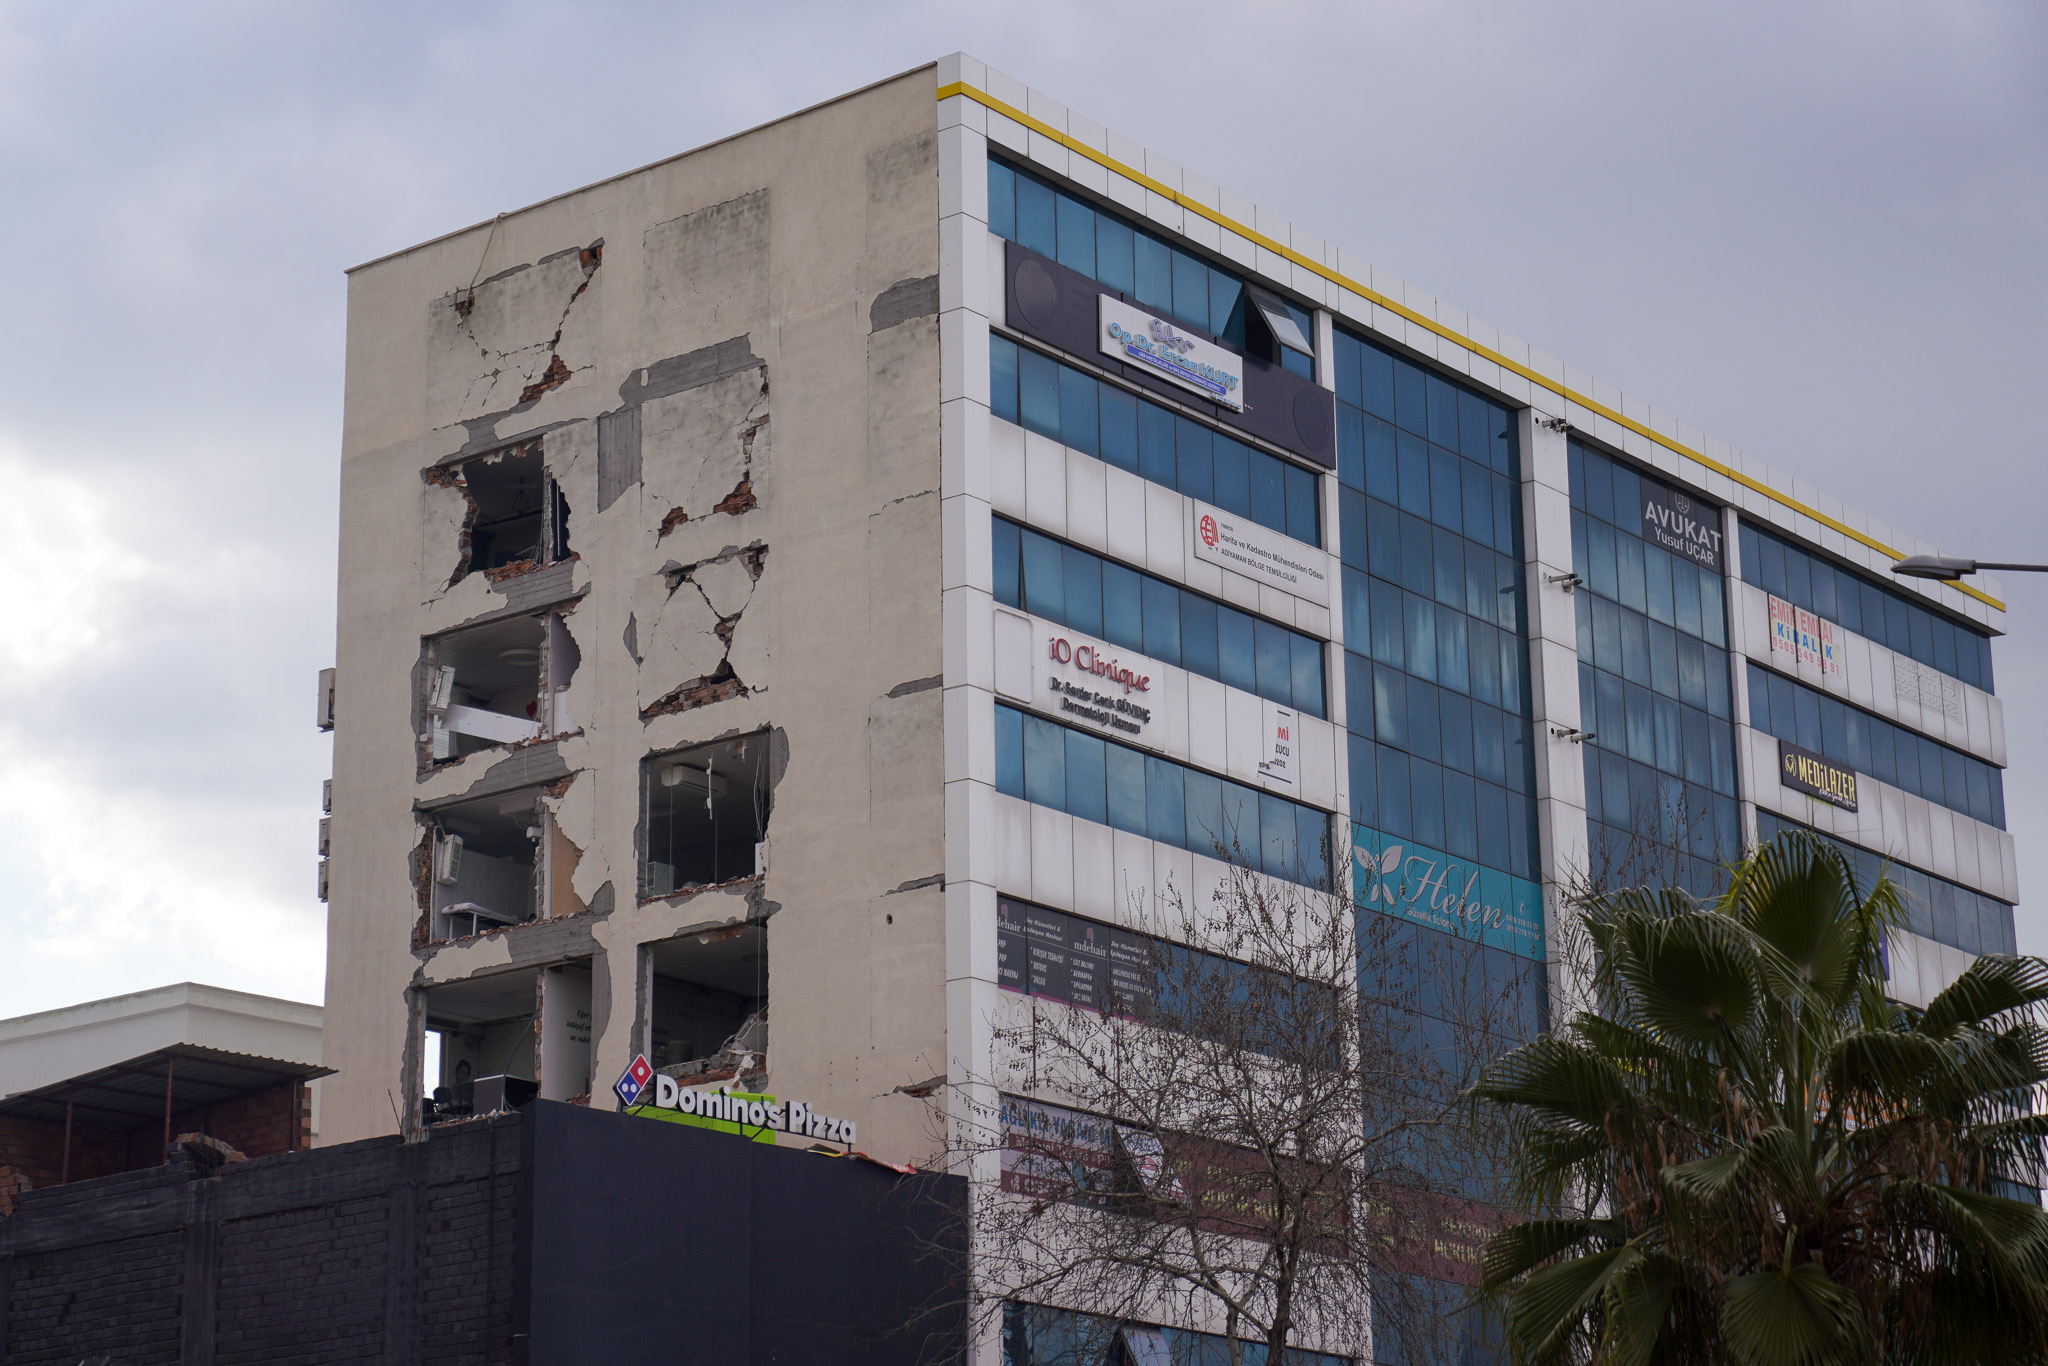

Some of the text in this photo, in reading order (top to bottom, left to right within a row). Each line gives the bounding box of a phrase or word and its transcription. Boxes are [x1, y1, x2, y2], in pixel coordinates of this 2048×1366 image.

[1108, 322, 1239, 390] Op. Dr. Ercan KURT
[1645, 501, 1721, 552] AVUKAT
[1655, 526, 1714, 565] Yusuf UÇAR
[1221, 532, 1238, 546] Harita
[1246, 542, 1271, 560] Kadastro
[1273, 553, 1308, 575] Mühendisleri
[1308, 568, 1324, 581] Odası
[1221, 548, 1247, 563] ADIYAMAN
[1248, 558, 1265, 571] BÖLGE
[1075, 645, 1150, 693] Clinique
[1773, 636, 1794, 655] 0505
[1830, 662, 1839, 676] 91
[1050, 677, 1063, 692] Dr.
[1061, 697, 1109, 726] Dermatoloji
[1798, 755, 1856, 802] MEDiLAZER
[1400, 855, 1505, 929] Helen
[655, 1073, 857, 1145] Domino's Pizza
